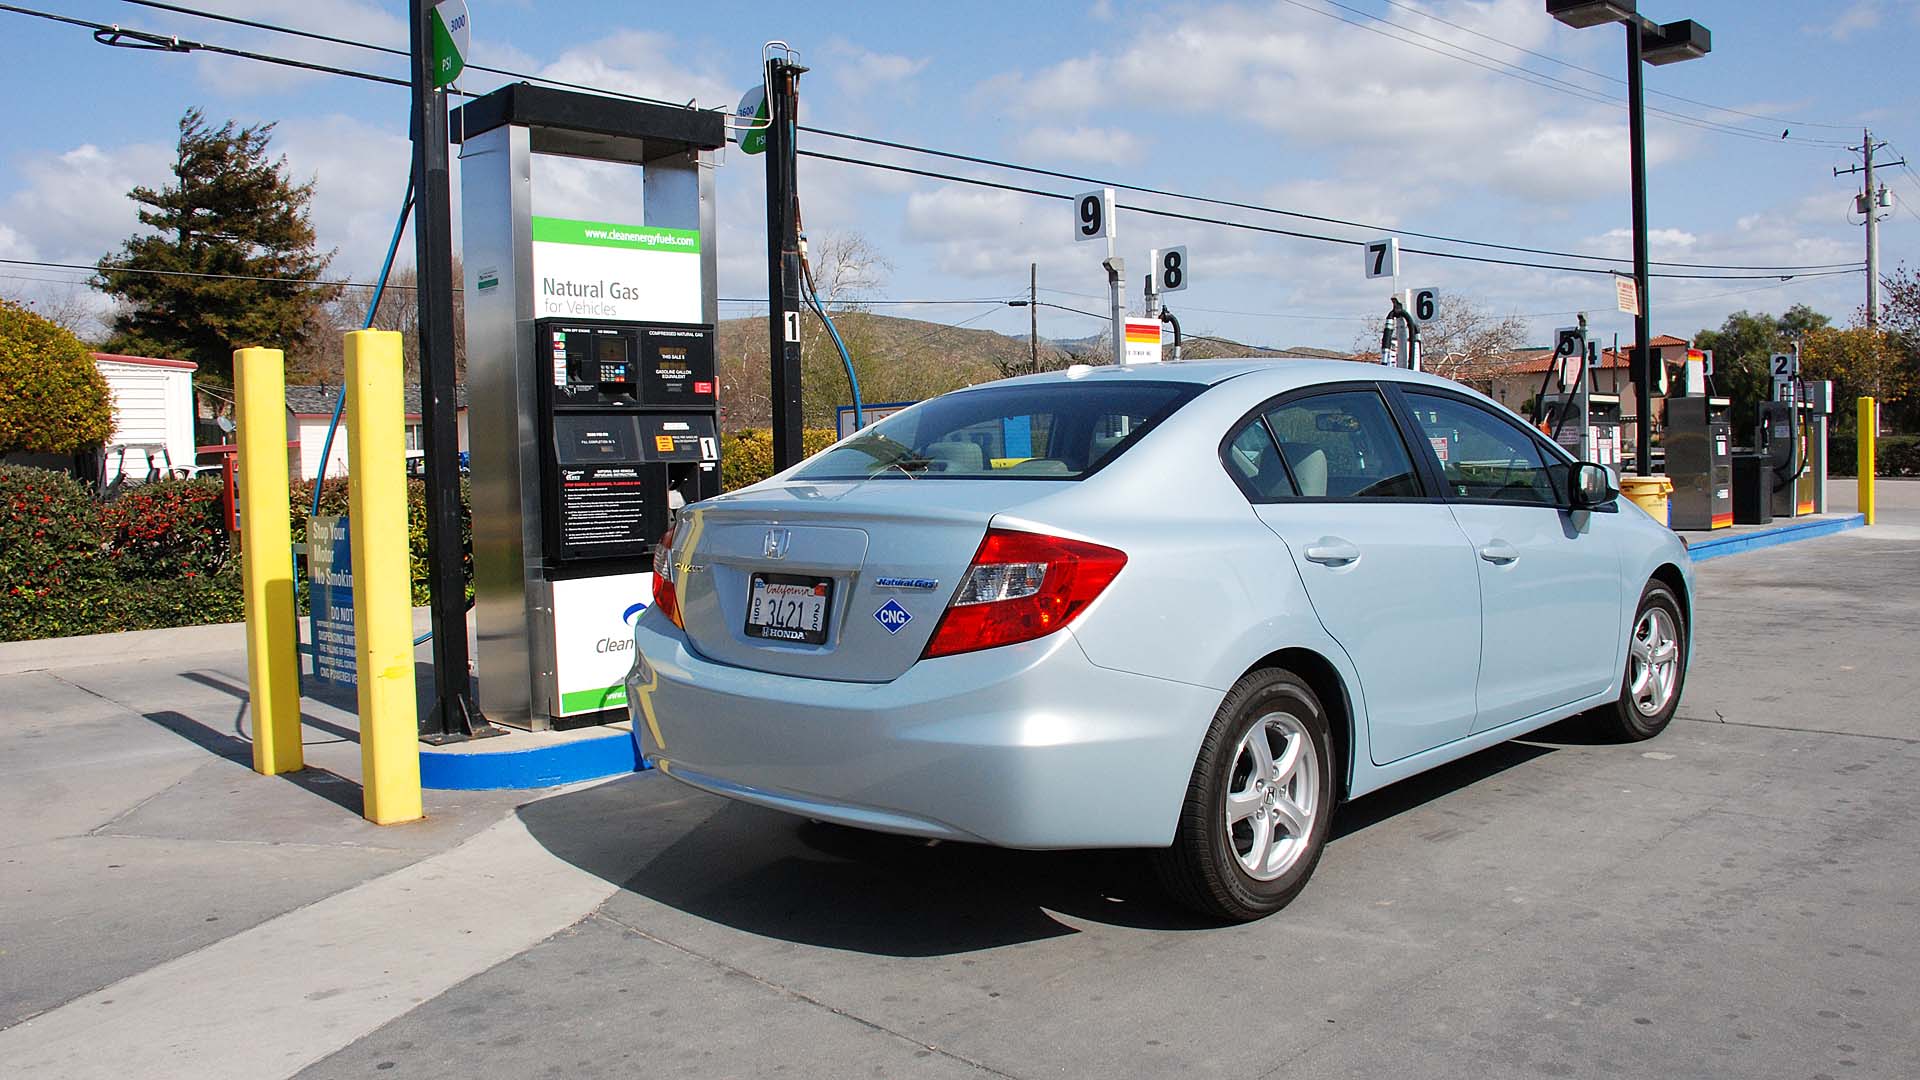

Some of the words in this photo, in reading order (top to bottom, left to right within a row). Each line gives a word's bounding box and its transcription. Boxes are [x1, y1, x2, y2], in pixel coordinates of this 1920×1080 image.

[451, 14, 466, 33] 3000
[442, 56, 452, 72] PSI
[1080, 195, 1102, 236] 9
[584, 228, 695, 247] www.cleanenergyfuels.com
[1369, 244, 1387, 275] 7
[1163, 251, 1182, 289] 8
[543, 277, 604, 299] Natural
[609, 282, 640, 301] Gas
[544, 299, 563, 313] for
[566, 299, 617, 316] Vehicles
[1416, 290, 1434, 320] 6
[788, 313, 797, 341] 1
[1774, 356, 1788, 375] 2
[704, 439, 714, 458] 1
[313, 521, 329, 545] Stop
[329, 522, 346, 540] Your
[314, 543, 335, 563] Motor
[314, 566, 326, 585] No
[326, 568, 354, 588] Smokin
[879, 578, 914, 587] Natural
[914, 579, 935, 589] Gas
[331, 606, 340, 620] DO
[340, 607, 354, 622] NOT
[767, 599, 804, 628] 3421
[880, 609, 906, 624] CNG
[769, 628, 806, 640] HONDA
[596, 637, 634, 653] Clean
